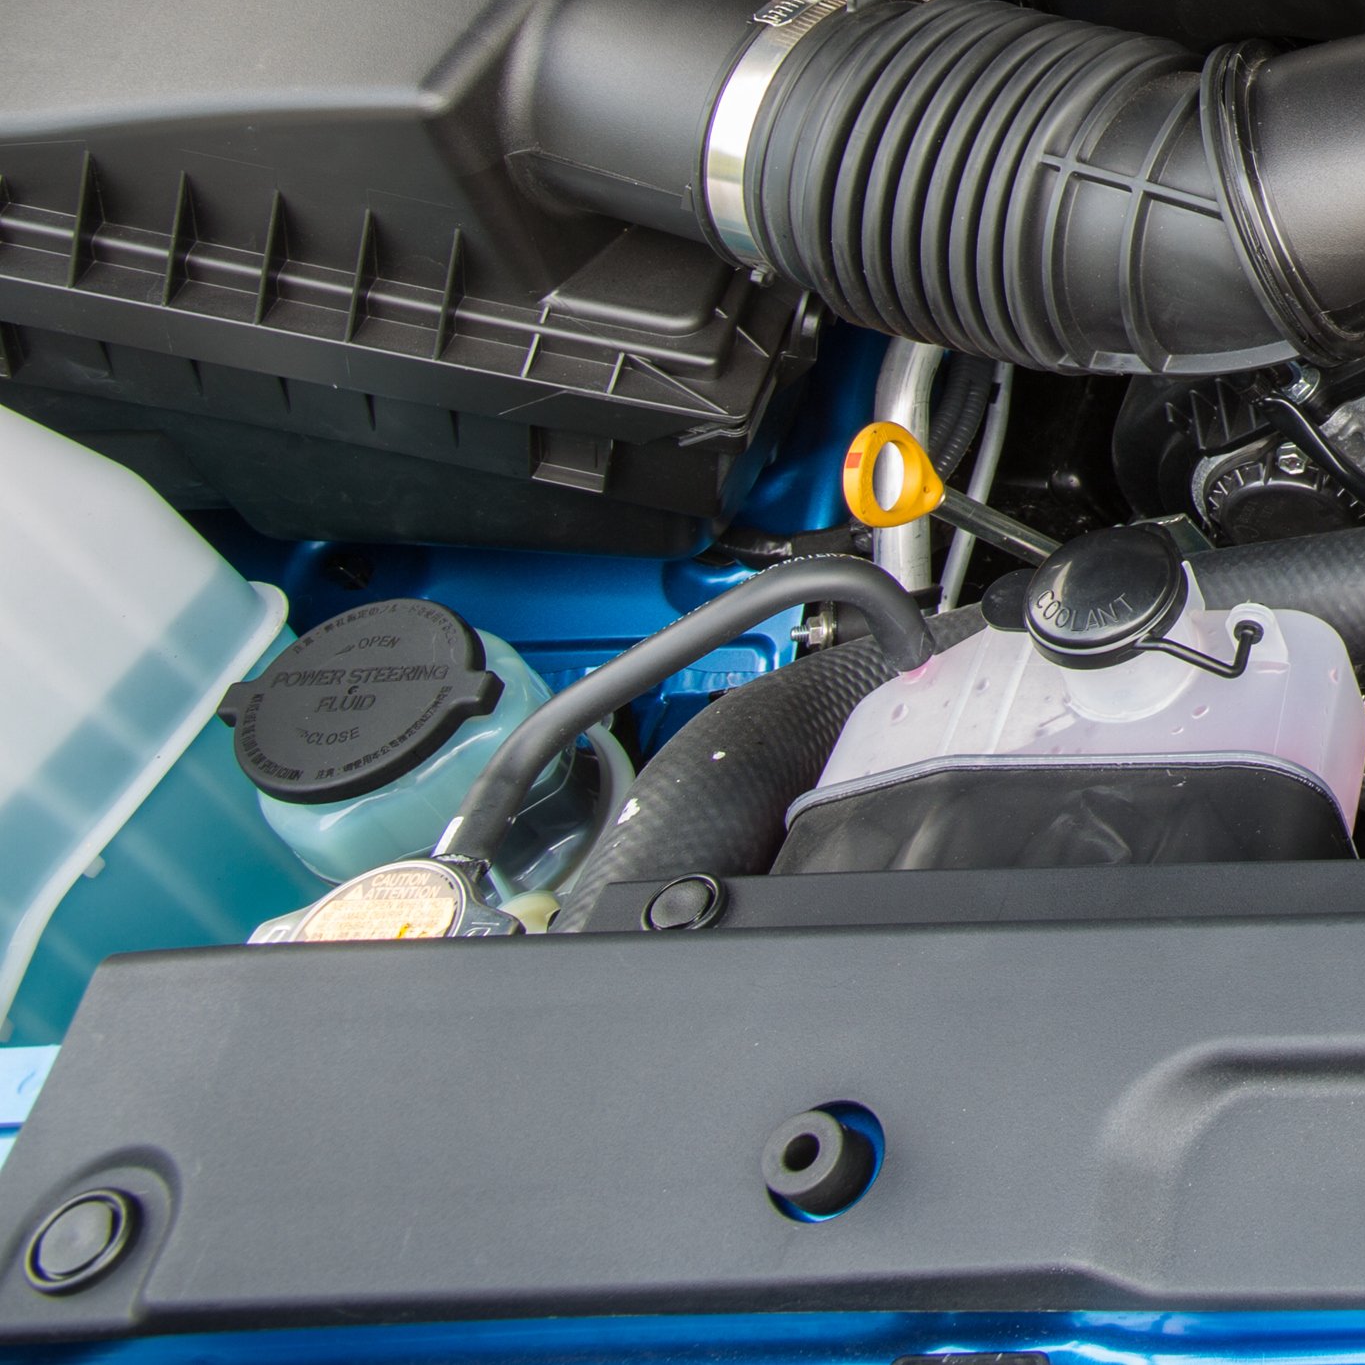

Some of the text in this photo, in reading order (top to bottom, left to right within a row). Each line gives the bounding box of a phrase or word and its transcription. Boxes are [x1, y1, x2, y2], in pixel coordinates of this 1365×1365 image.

[1036, 589, 1134, 632] COOLANT
[357, 635, 400, 650] OPEN
[270, 664, 450, 688] POWER STEERING
[314, 694, 377, 713] FLUID
[304, 726, 361, 746] CLOSE
[371, 872, 431, 887] CAUTION
[364, 885, 441, 900] ATTENTION
